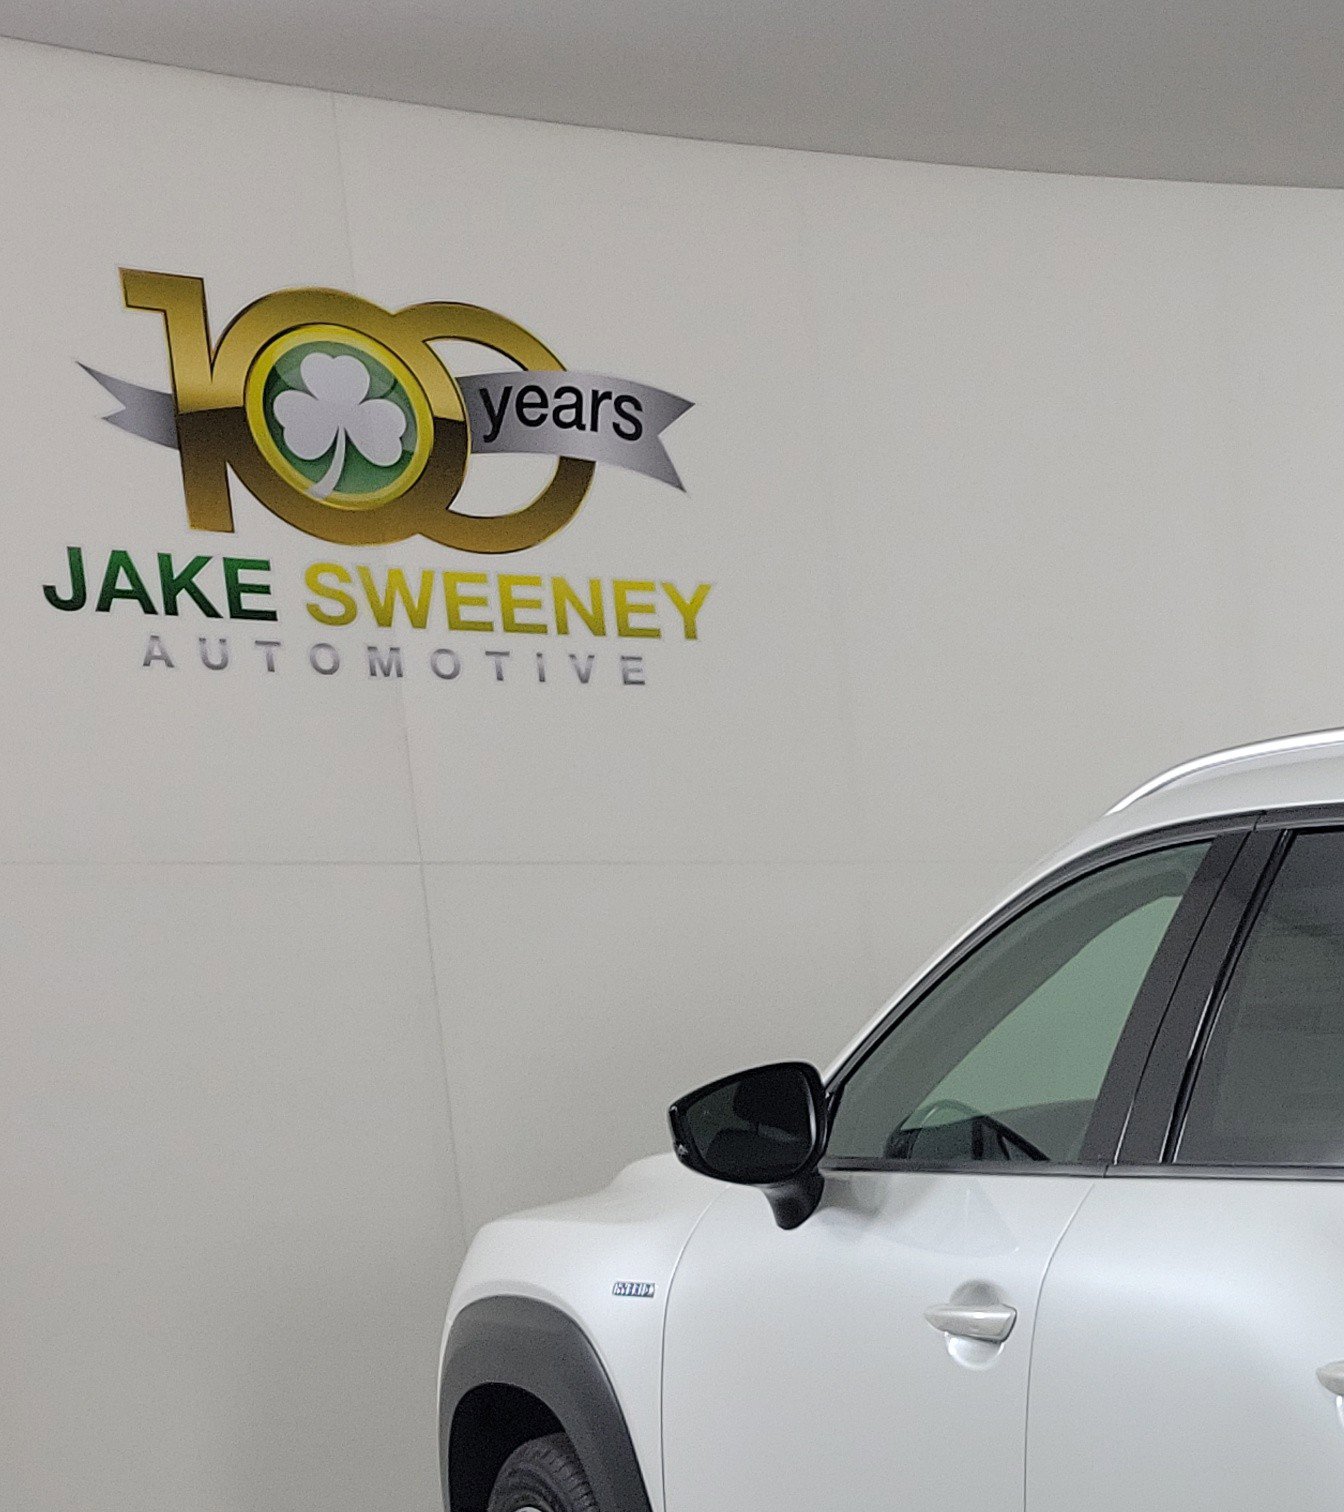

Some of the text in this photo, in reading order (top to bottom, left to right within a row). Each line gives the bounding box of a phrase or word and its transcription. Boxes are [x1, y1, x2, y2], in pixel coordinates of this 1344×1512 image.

[119, 267, 645, 554] 100 years
[43, 545, 714, 642] JAKE SWEENEY
[142, 634, 647, 687] AUTOMOTIVE
